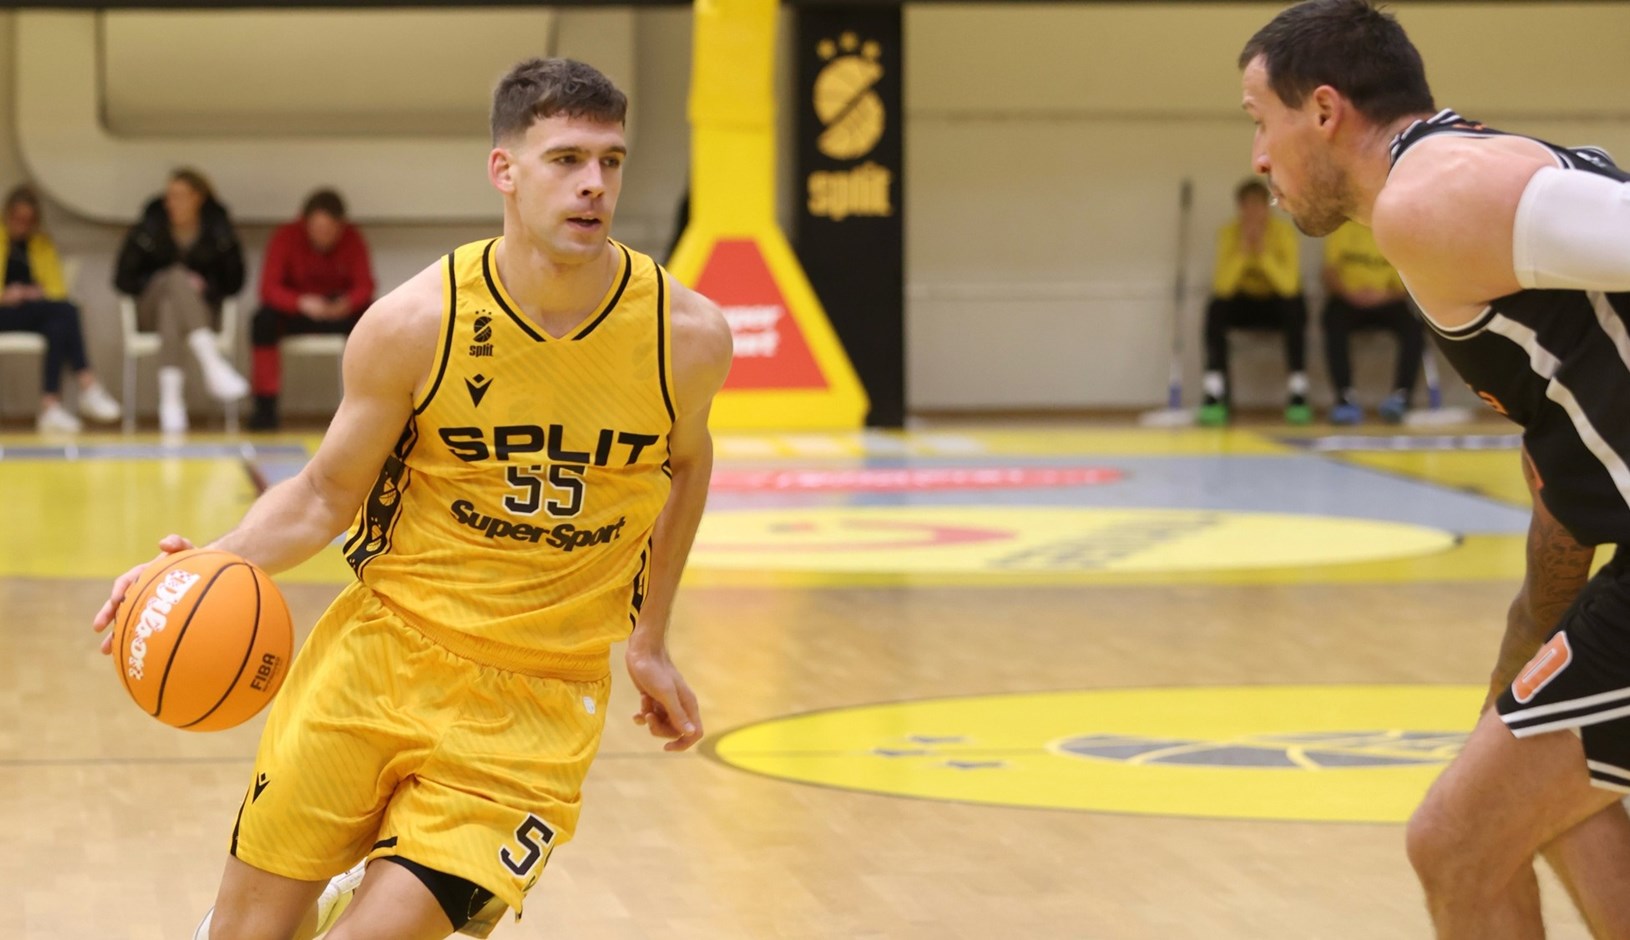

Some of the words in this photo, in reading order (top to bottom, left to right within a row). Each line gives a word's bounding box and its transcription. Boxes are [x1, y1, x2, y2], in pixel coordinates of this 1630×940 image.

[469, 343, 494, 358] split
[438, 424, 660, 466] SPLIT
[502, 464, 585, 519] 55
[250, 653, 276, 692] FIBA
